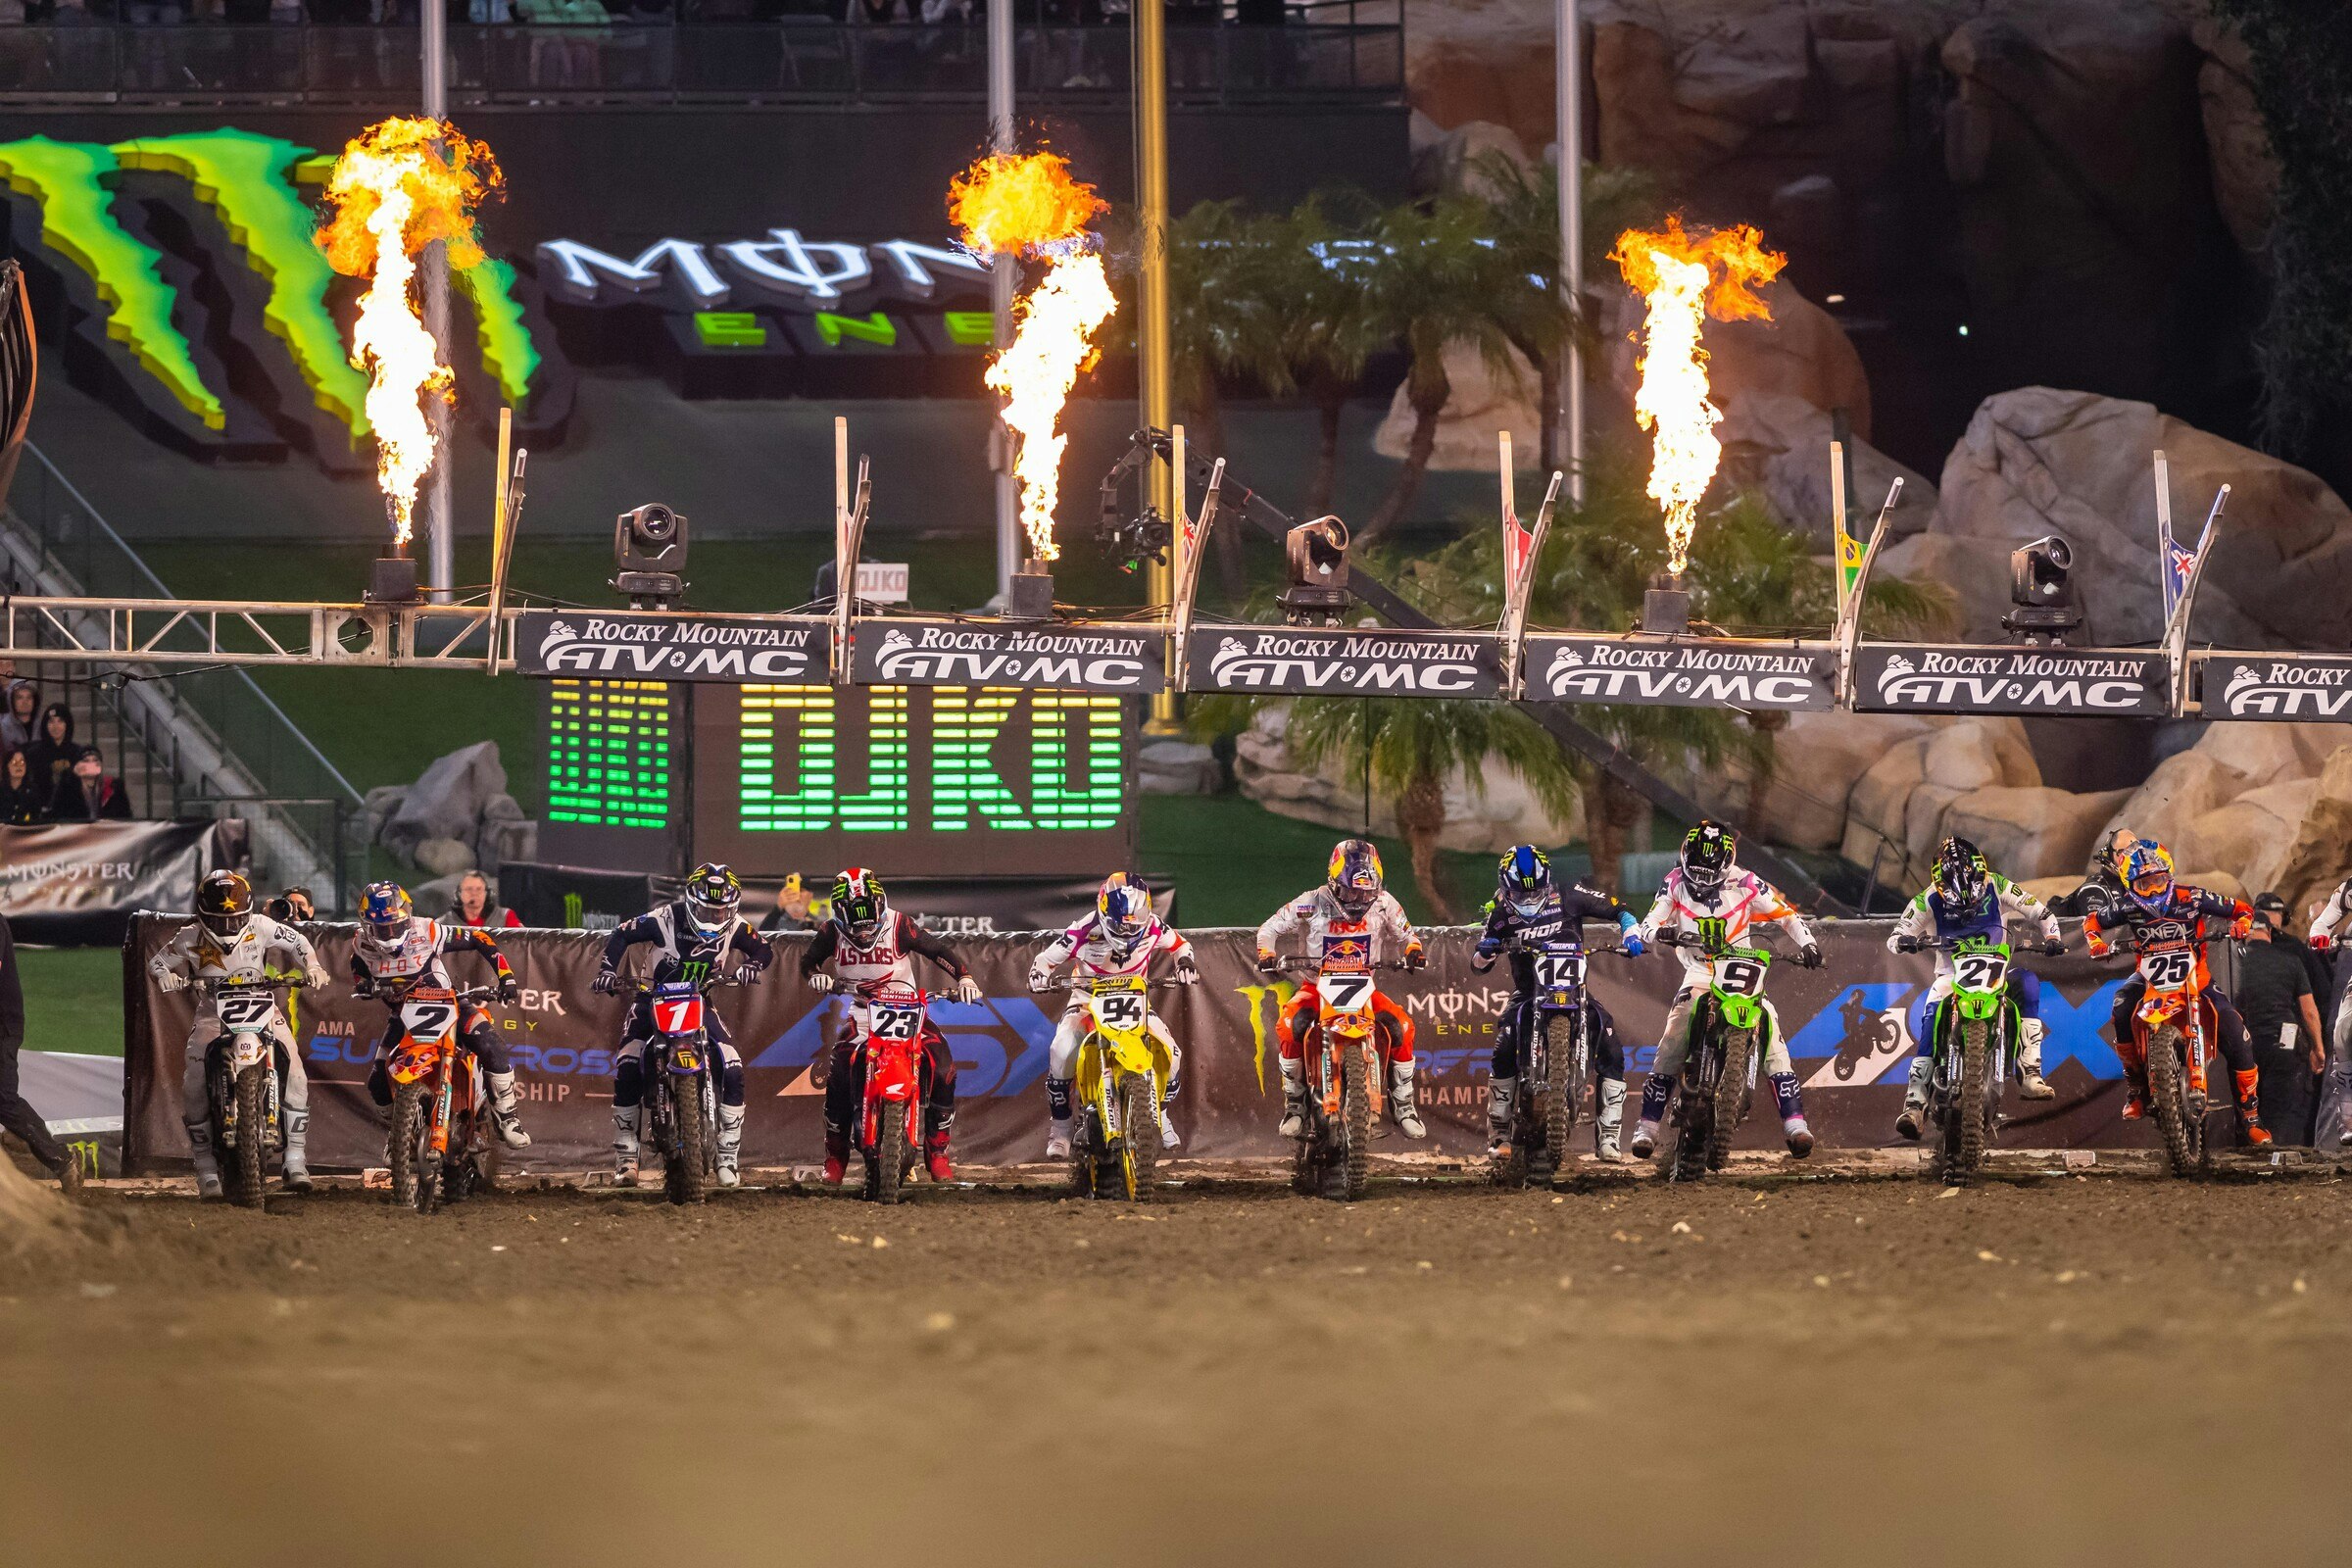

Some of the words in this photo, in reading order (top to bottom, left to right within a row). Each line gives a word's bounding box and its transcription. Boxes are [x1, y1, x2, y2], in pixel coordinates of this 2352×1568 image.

[1538, 958, 1582, 986] 14
[1722, 962, 1762, 996] 9
[1958, 959, 2005, 989] 21
[2148, 954, 2190, 986] 25
[1329, 979, 1369, 1007] 7
[1406, 987, 1510, 1018] MONS
[220, 1000, 271, 1023] 27
[409, 1006, 450, 1036] 2
[668, 1001, 690, 1032] 1
[875, 1009, 919, 1038] 23
[1102, 998, 1142, 1024] 94
[317, 1020, 356, 1036] AMA
